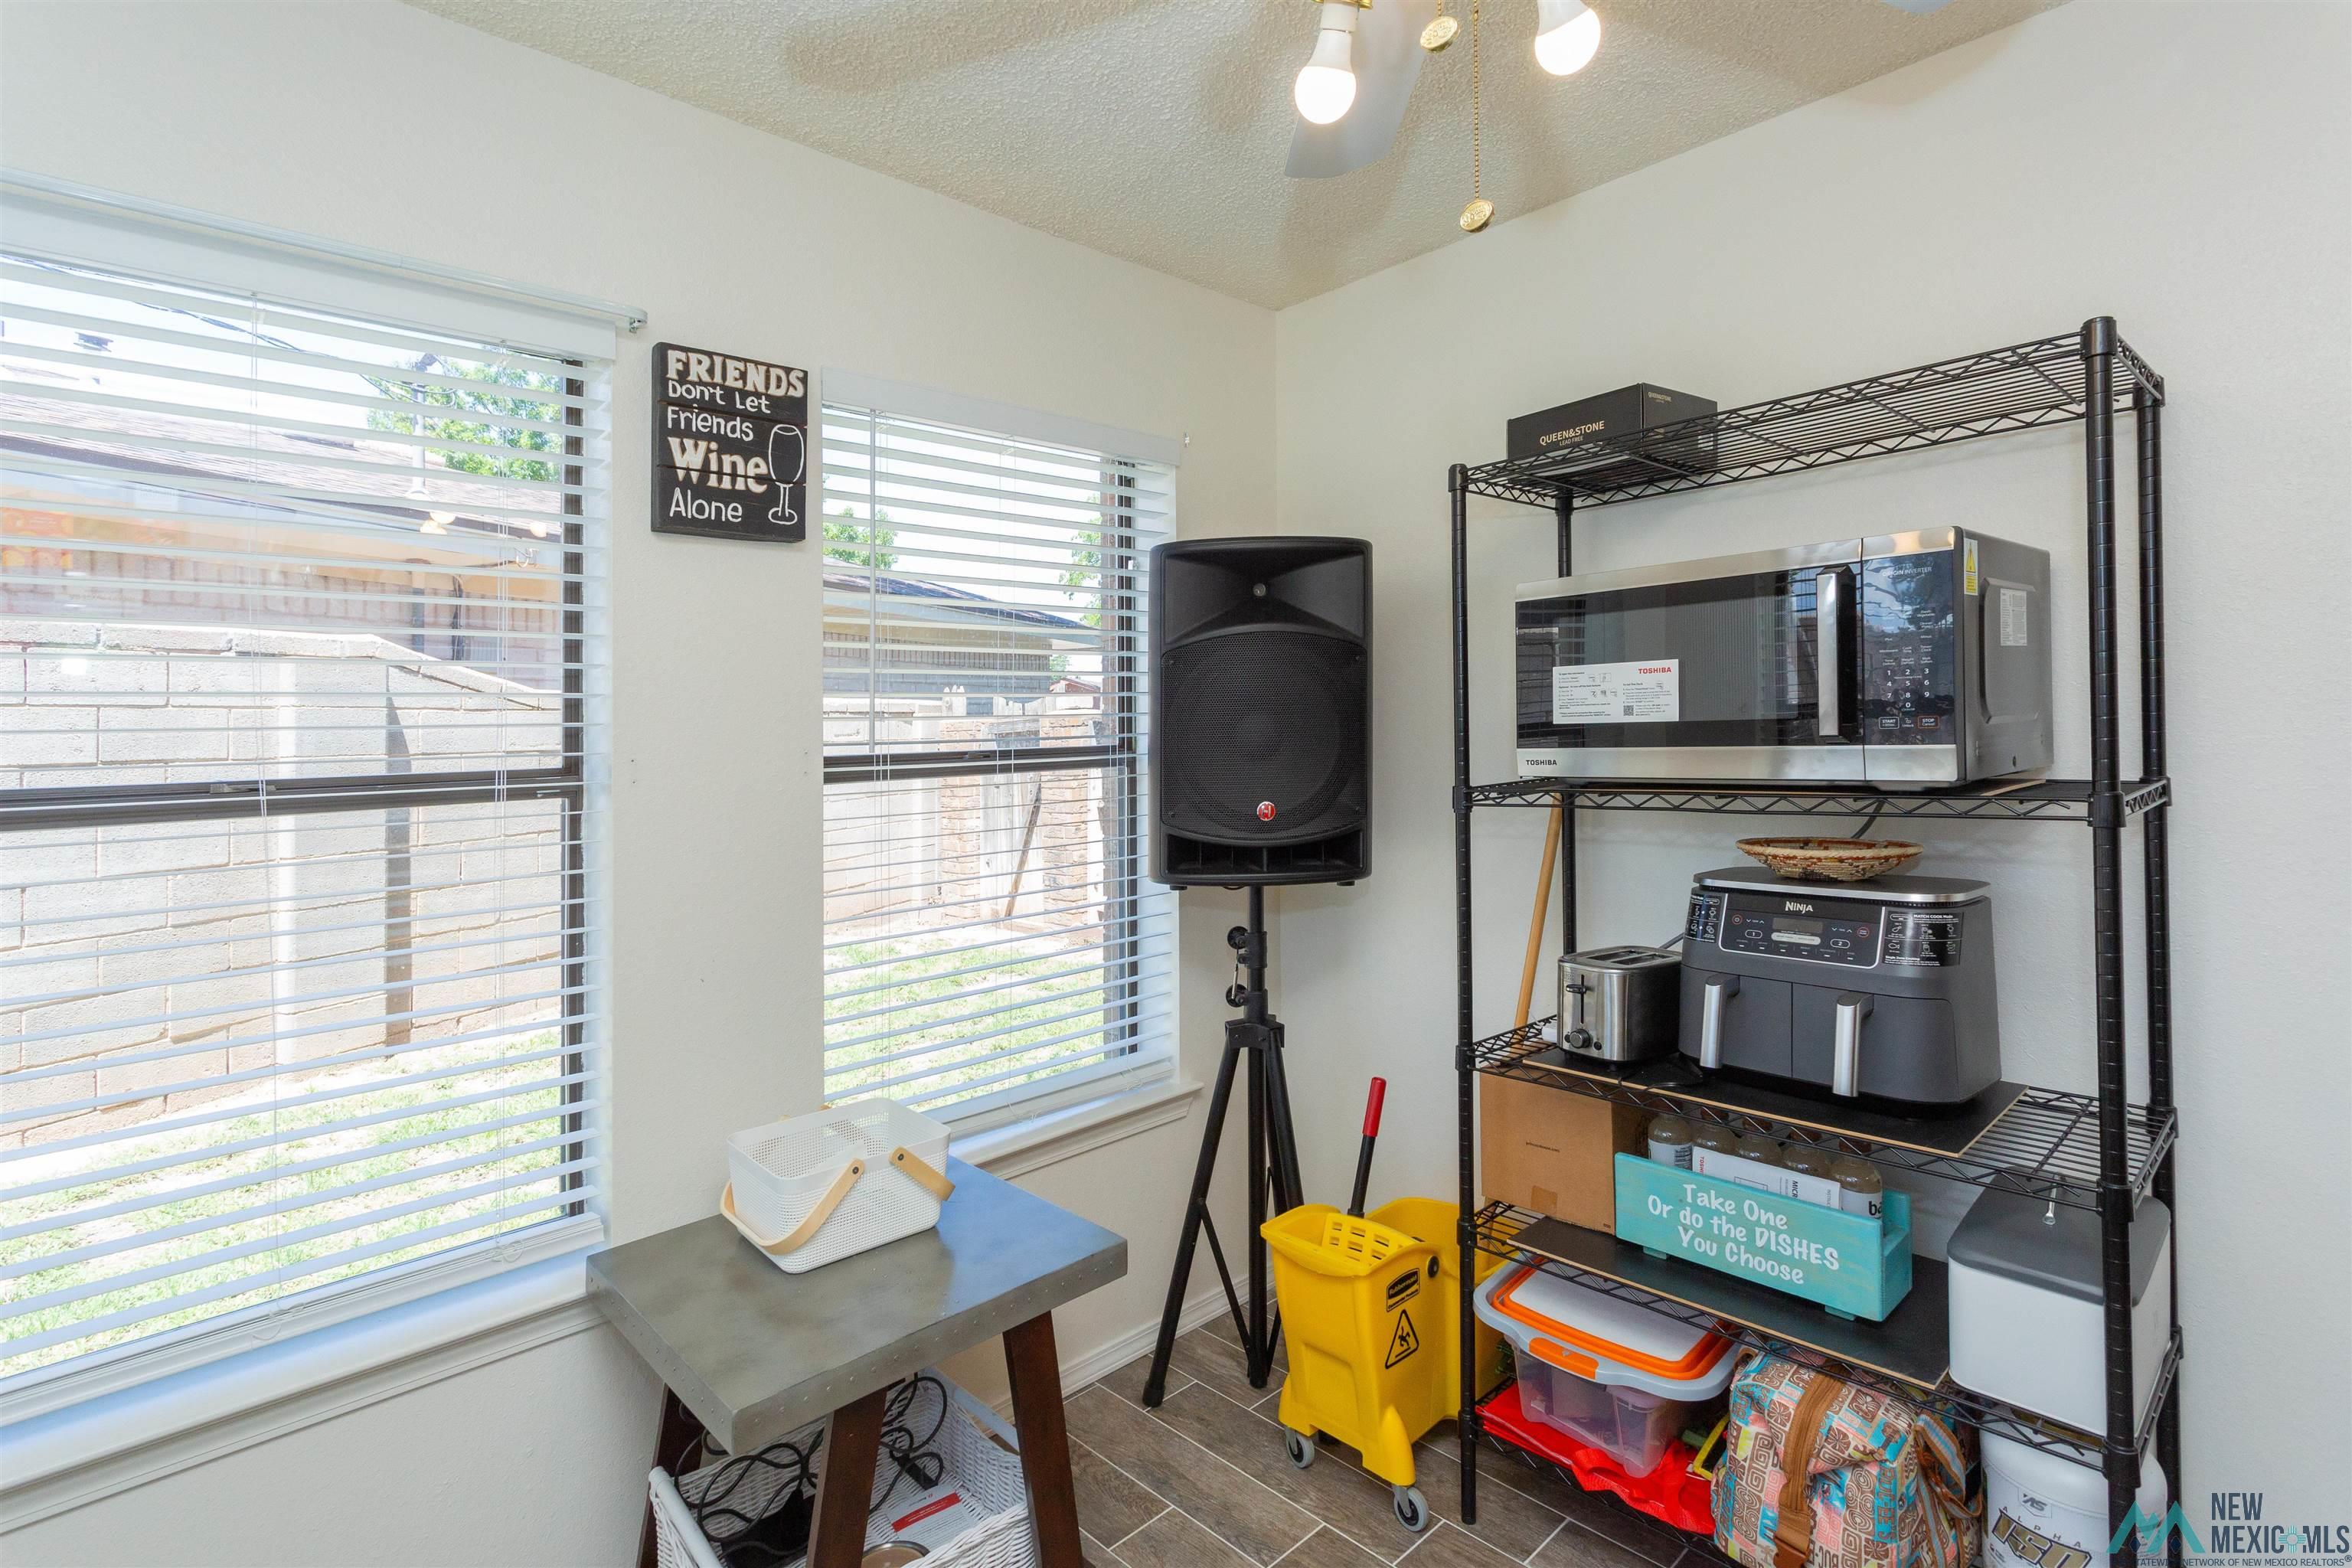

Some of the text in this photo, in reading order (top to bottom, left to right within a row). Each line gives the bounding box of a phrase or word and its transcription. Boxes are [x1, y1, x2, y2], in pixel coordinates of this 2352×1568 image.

[665, 349, 805, 398] FRIENDS
[668, 380, 771, 413] Don't Let
[667, 404, 754, 442] Friends
[1540, 420, 1605, 446] QUEEN&STONE
[1560, 438, 1571, 446] LEAD
[667, 436, 769, 494] Wine
[669, 487, 743, 522] Alone
[1904, 567, 1932, 575] INVERTER
[1785, 901, 1814, 914] NINJA
[1683, 1183, 1788, 1230] Take One
[1648, 1194, 1839, 1271] Or do the DISHES
[1677, 1226, 1805, 1285] You Choose
[2002, 1506, 2082, 1548] ALPHA
